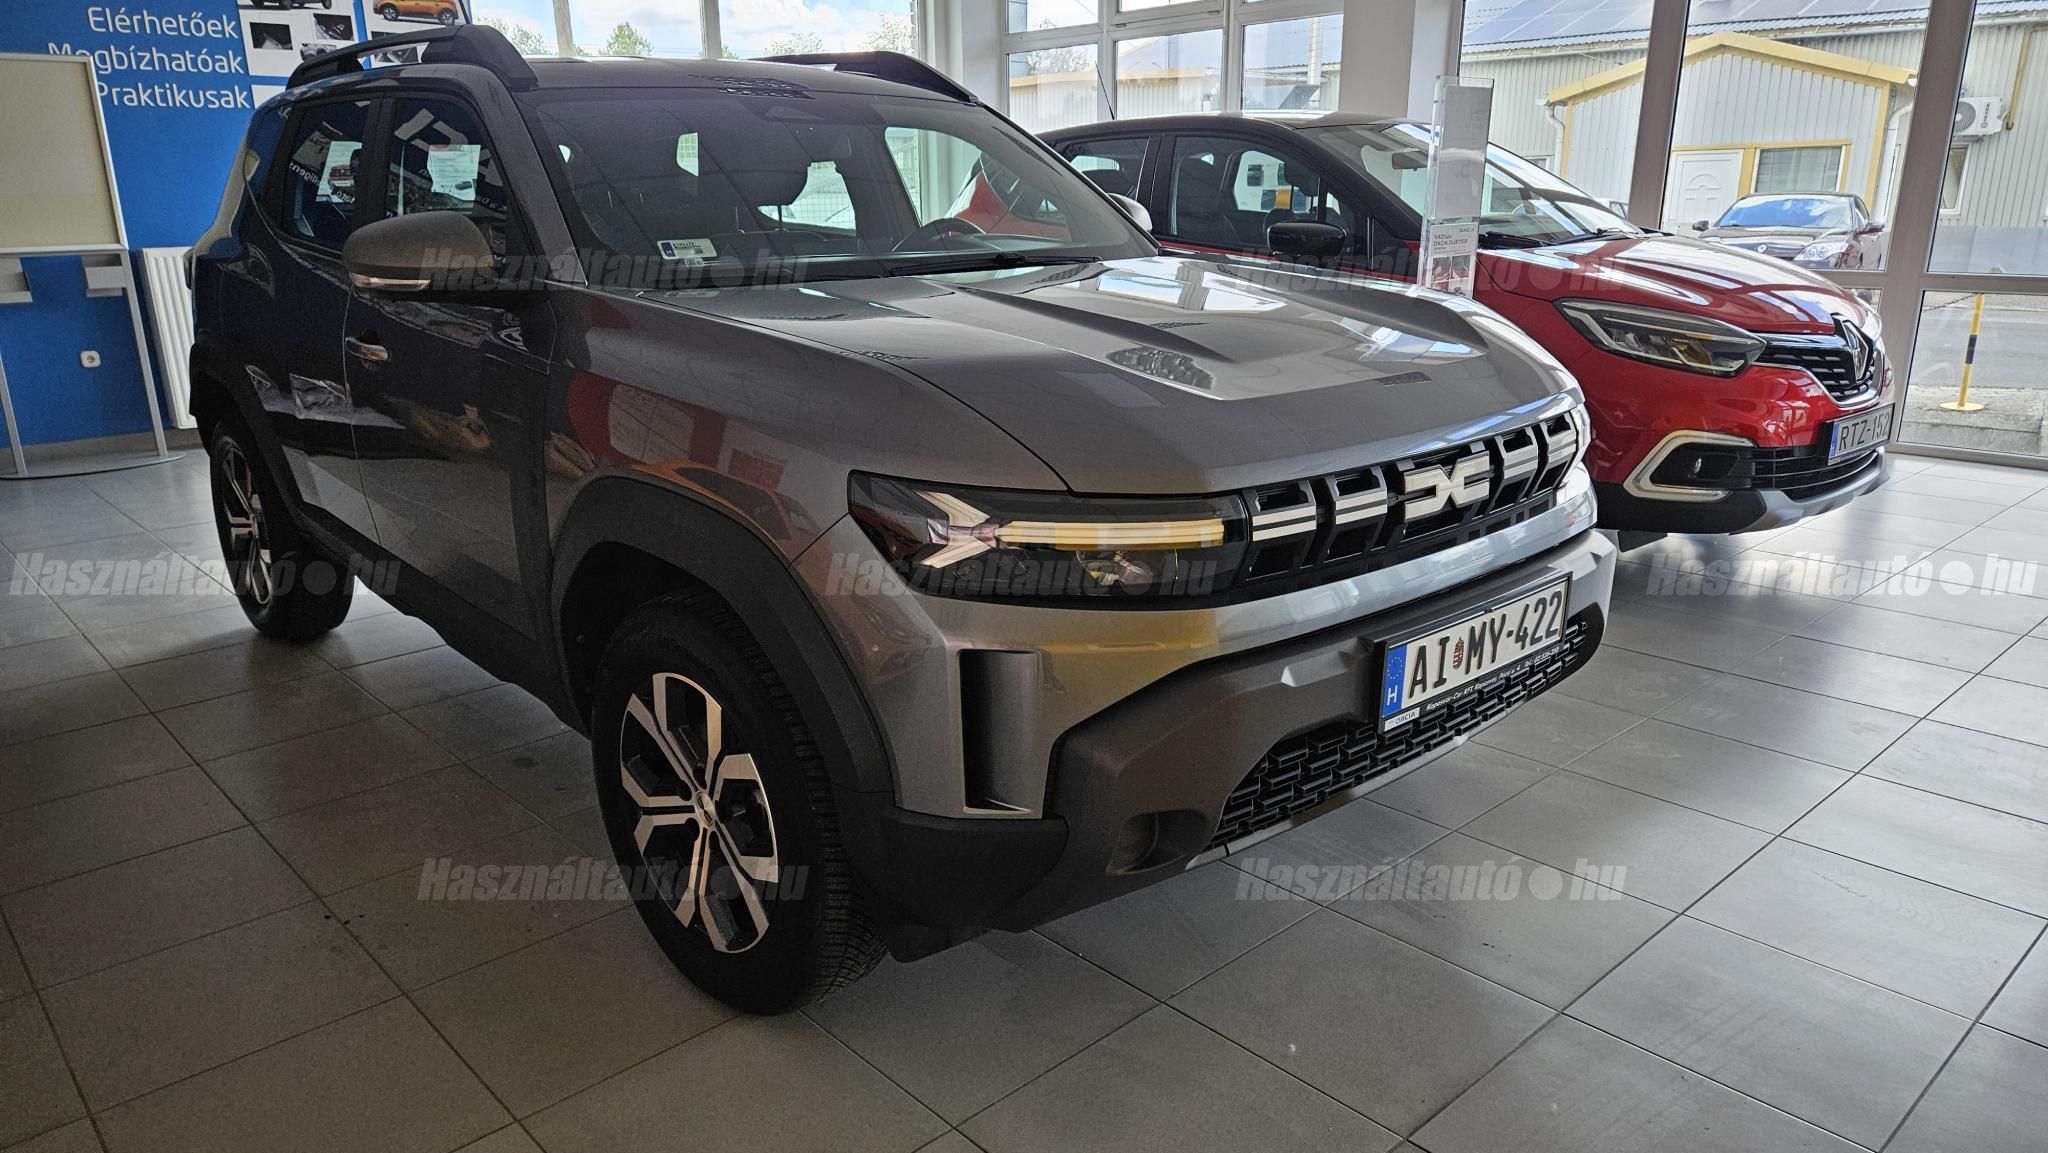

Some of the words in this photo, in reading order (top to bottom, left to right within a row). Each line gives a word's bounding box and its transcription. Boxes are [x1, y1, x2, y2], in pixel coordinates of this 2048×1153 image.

[87, 7, 239, 39] Elérhetőek
[48, 43, 244, 74] Mgbízhatóak
[98, 82, 250, 109] Praktikusak
[1838, 411, 1890, 452] RTZ-152
[1408, 635, 1451, 698] AI
[1464, 589, 1563, 675] MY-422
[1386, 684, 1398, 706] H
